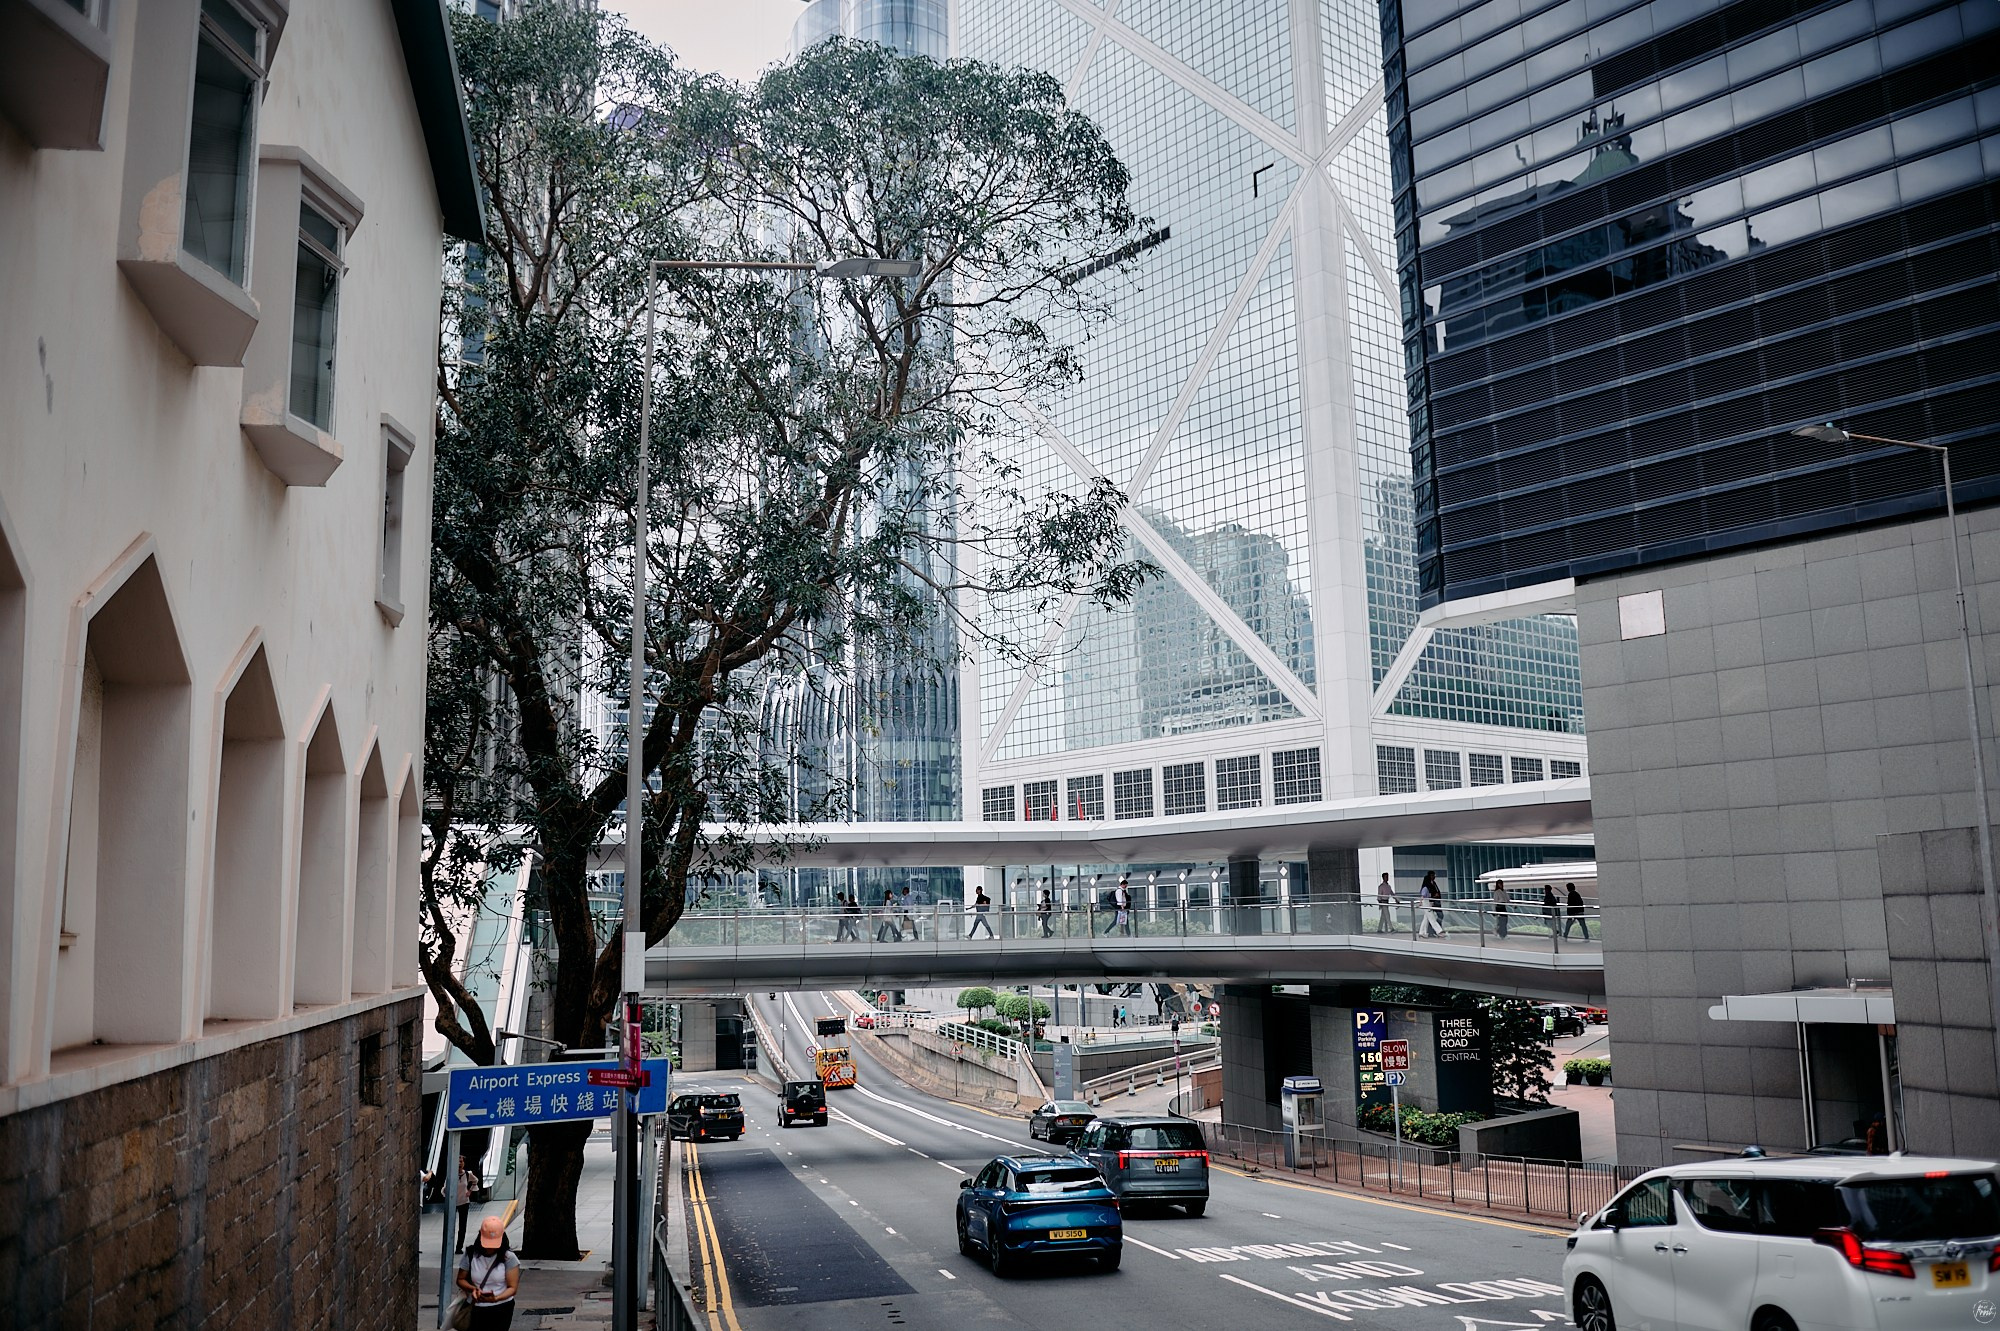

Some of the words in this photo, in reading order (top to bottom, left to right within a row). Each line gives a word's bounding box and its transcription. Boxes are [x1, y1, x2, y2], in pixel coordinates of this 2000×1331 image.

[1356, 1012, 1369, 1029] P
[1440, 1018, 1472, 1028] THREE
[1440, 1028, 1480, 1038] GARDEN
[1382, 1044, 1407, 1053] SLOW
[1440, 1038, 1469, 1048] ROAD
[1384, 1055, 1407, 1068] 慢駛
[1441, 1053, 1480, 1062] CENTRAL
[469, 1074, 519, 1091] Airport
[527, 1071, 581, 1089] Express
[1388, 1074, 1396, 1084] P
[1066, 1230, 1083, 1238] 5150
[1175, 1241, 1382, 1263] ADMIRALTY
[1287, 1260, 1425, 1282] AND
[1954, 1268, 1967, 1280] 19
[1295, 1278, 1565, 1312] KOWLOON
